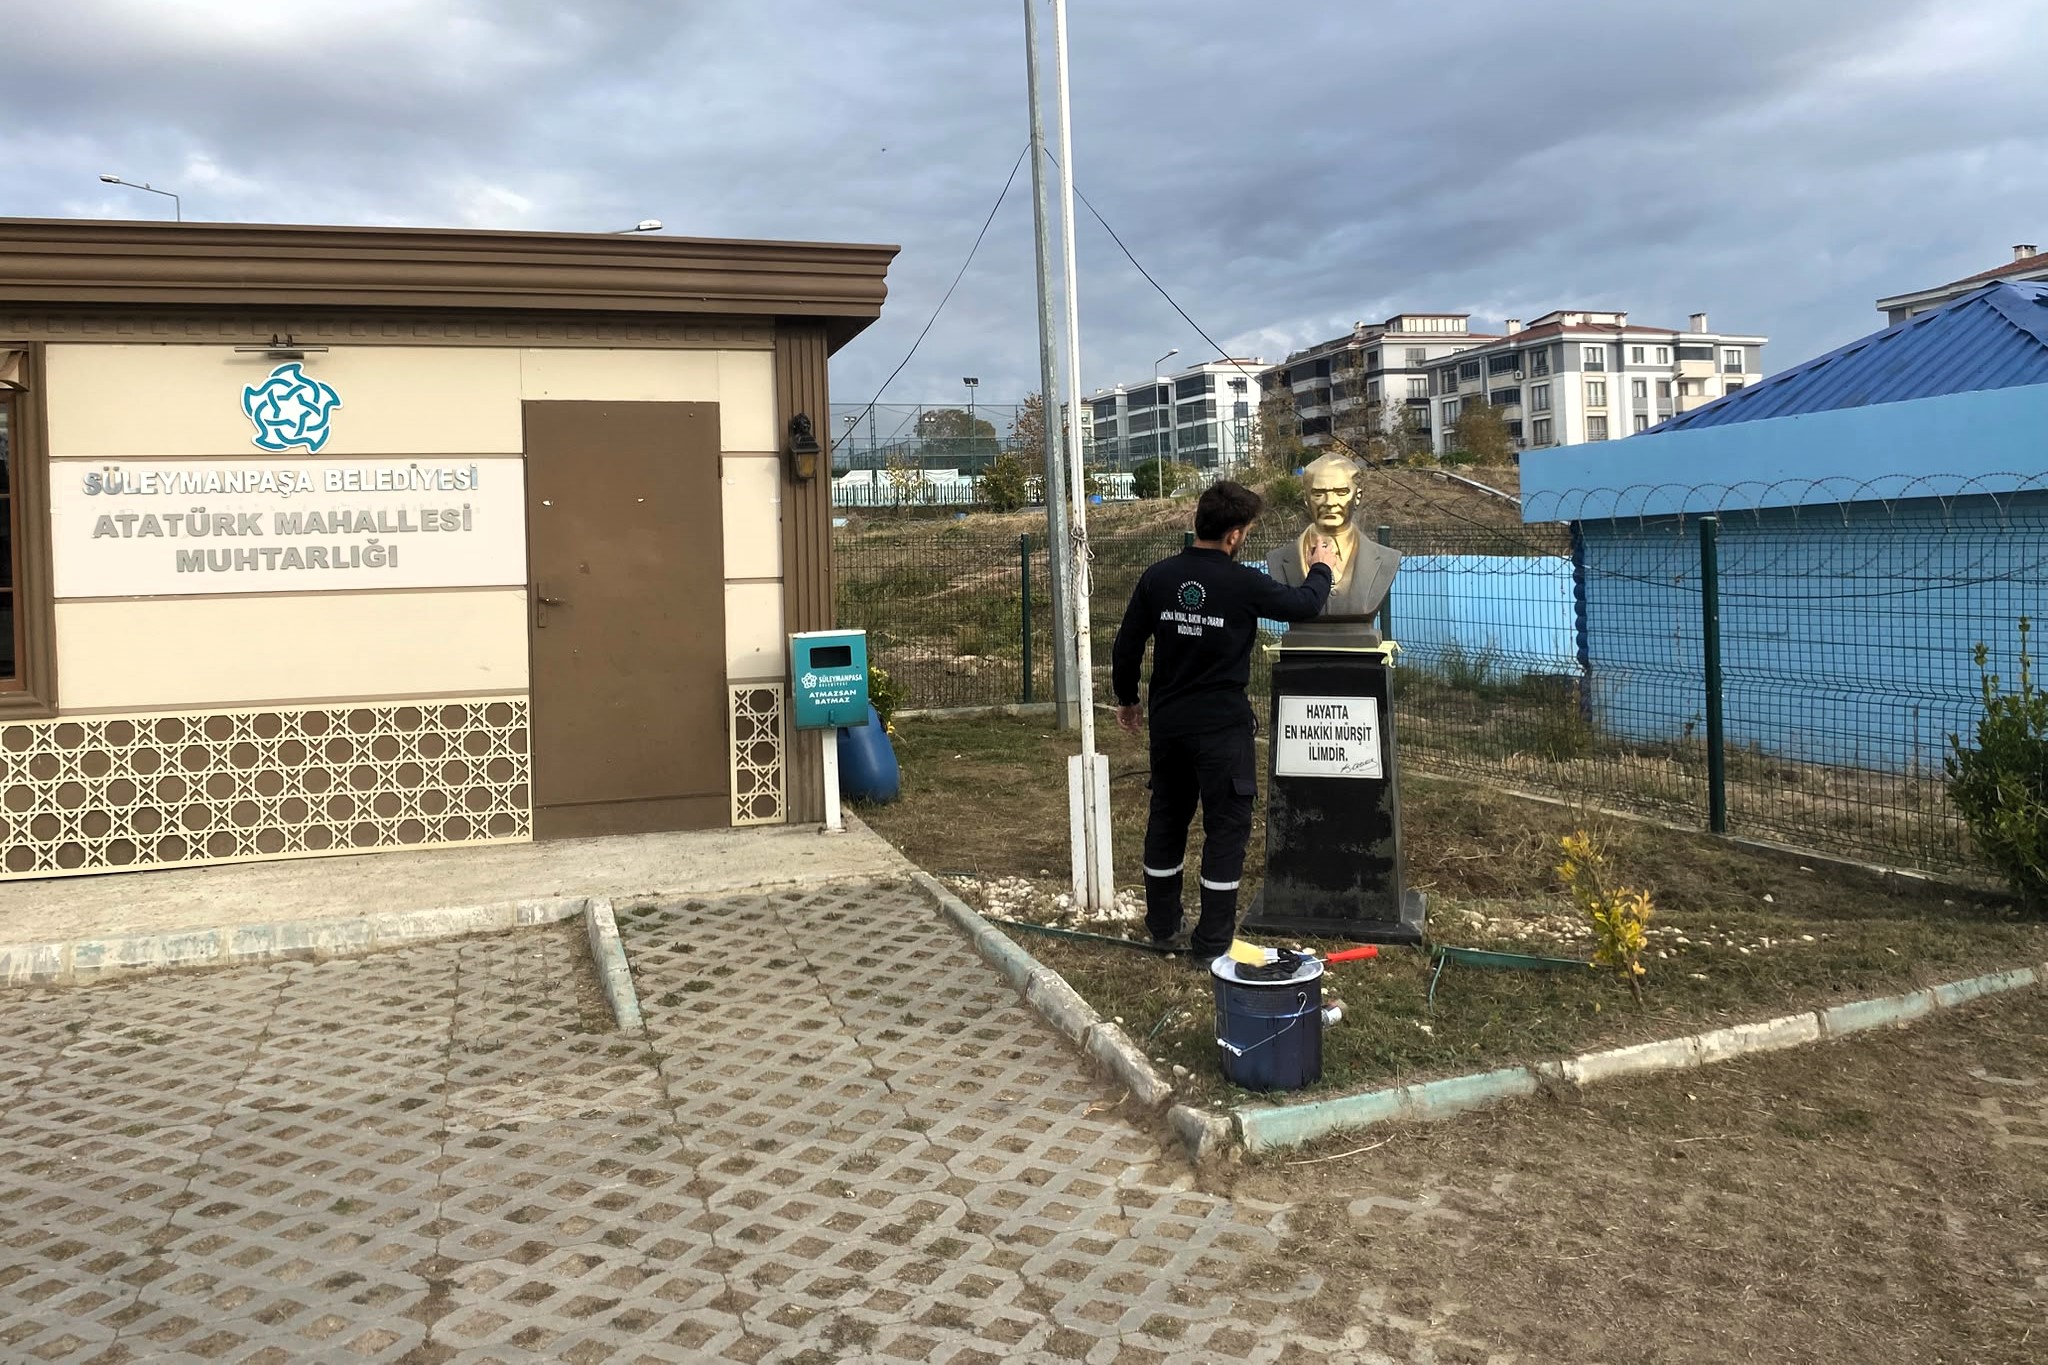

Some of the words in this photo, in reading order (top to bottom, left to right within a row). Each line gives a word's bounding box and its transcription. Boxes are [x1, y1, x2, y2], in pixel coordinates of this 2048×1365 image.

[83, 466, 315, 498] SÜLEYMANPAŞA
[324, 463, 479, 492] BELEDİYESİ
[92, 507, 264, 539] ATATÜRK
[274, 503, 473, 536] MAHALLESİ
[175, 538, 399, 573] MUHTARLIĞI
[809, 689, 857, 698] ATMAZSAN
[815, 697, 851, 705] BATMAZ
[1306, 704, 1349, 720] HAYATTA
[1285, 725, 1298, 740] EN
[1300, 722, 1333, 740] HAKİKİ
[1335, 722, 1372, 746] MÜRŞİT
[1309, 742, 1348, 762] İLİMDİR.
